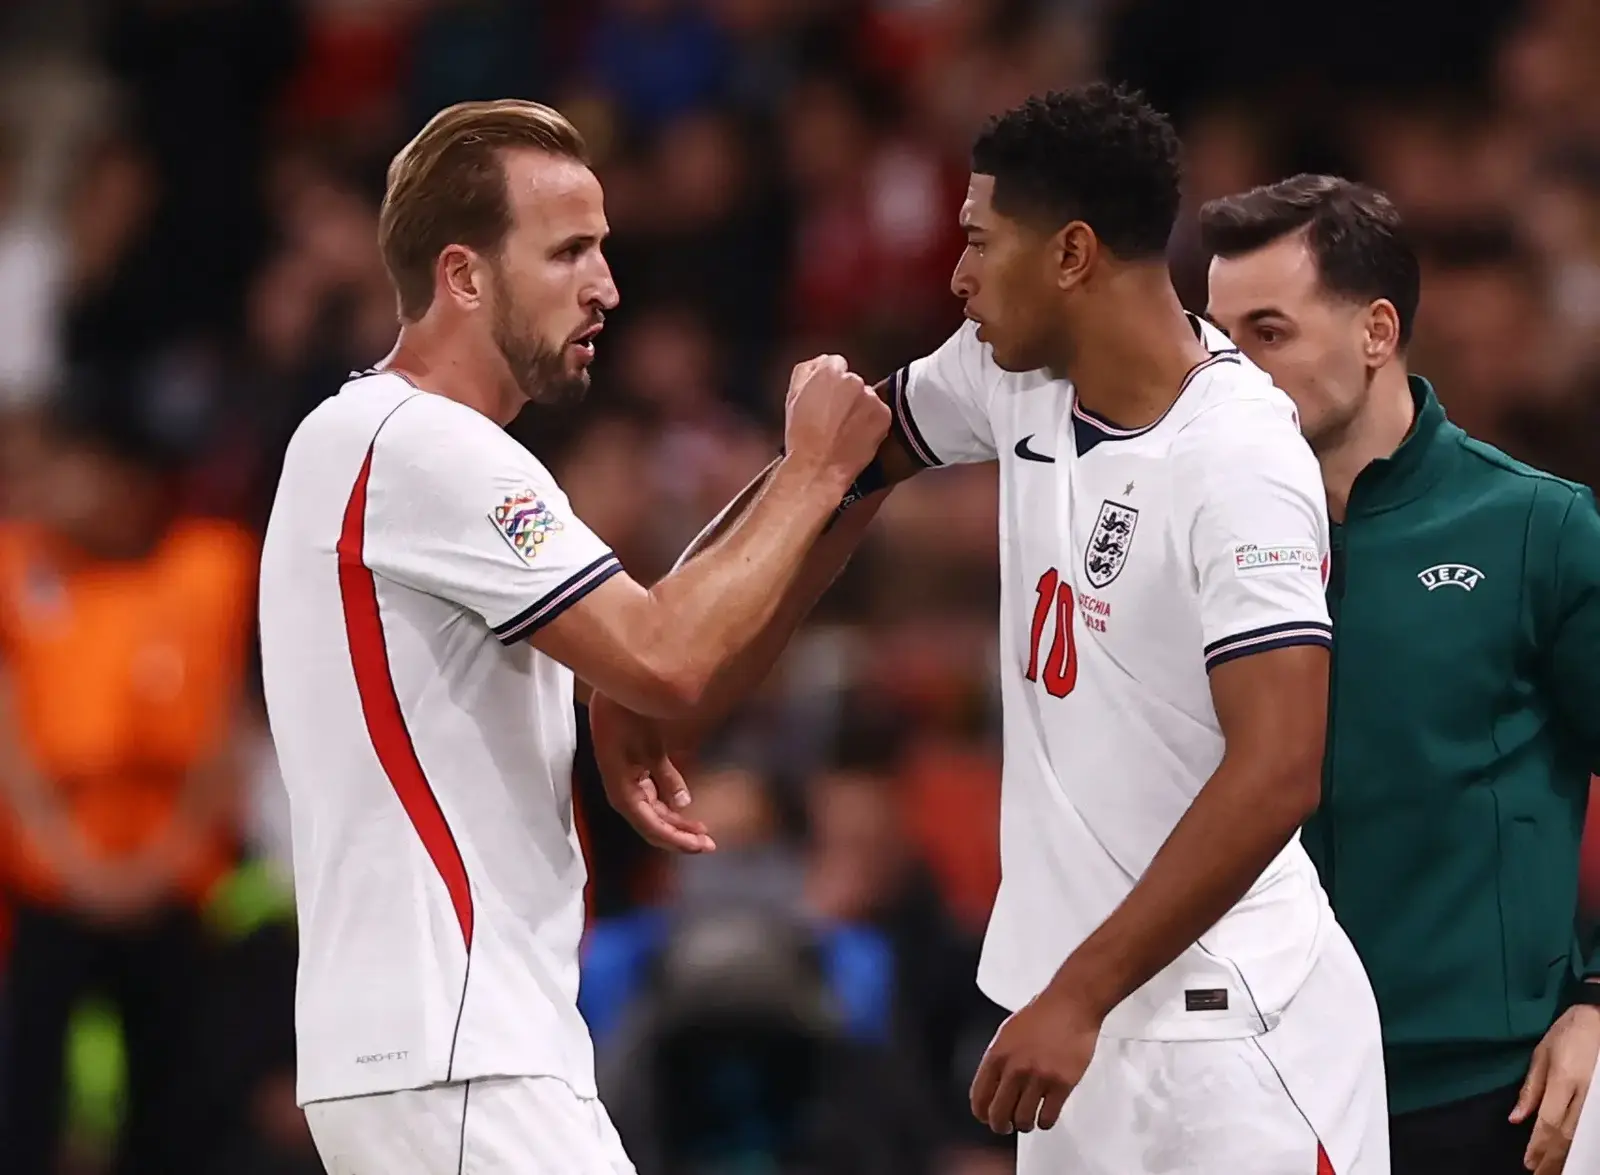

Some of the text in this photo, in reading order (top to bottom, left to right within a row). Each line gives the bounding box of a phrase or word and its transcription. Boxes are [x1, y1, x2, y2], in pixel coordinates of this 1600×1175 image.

[1235, 544, 1258, 553] UEFA
[1236, 550, 1319, 565] FOUNDATION
[1420, 566, 1479, 589] UEFA
[1025, 566, 1078, 699] 10
